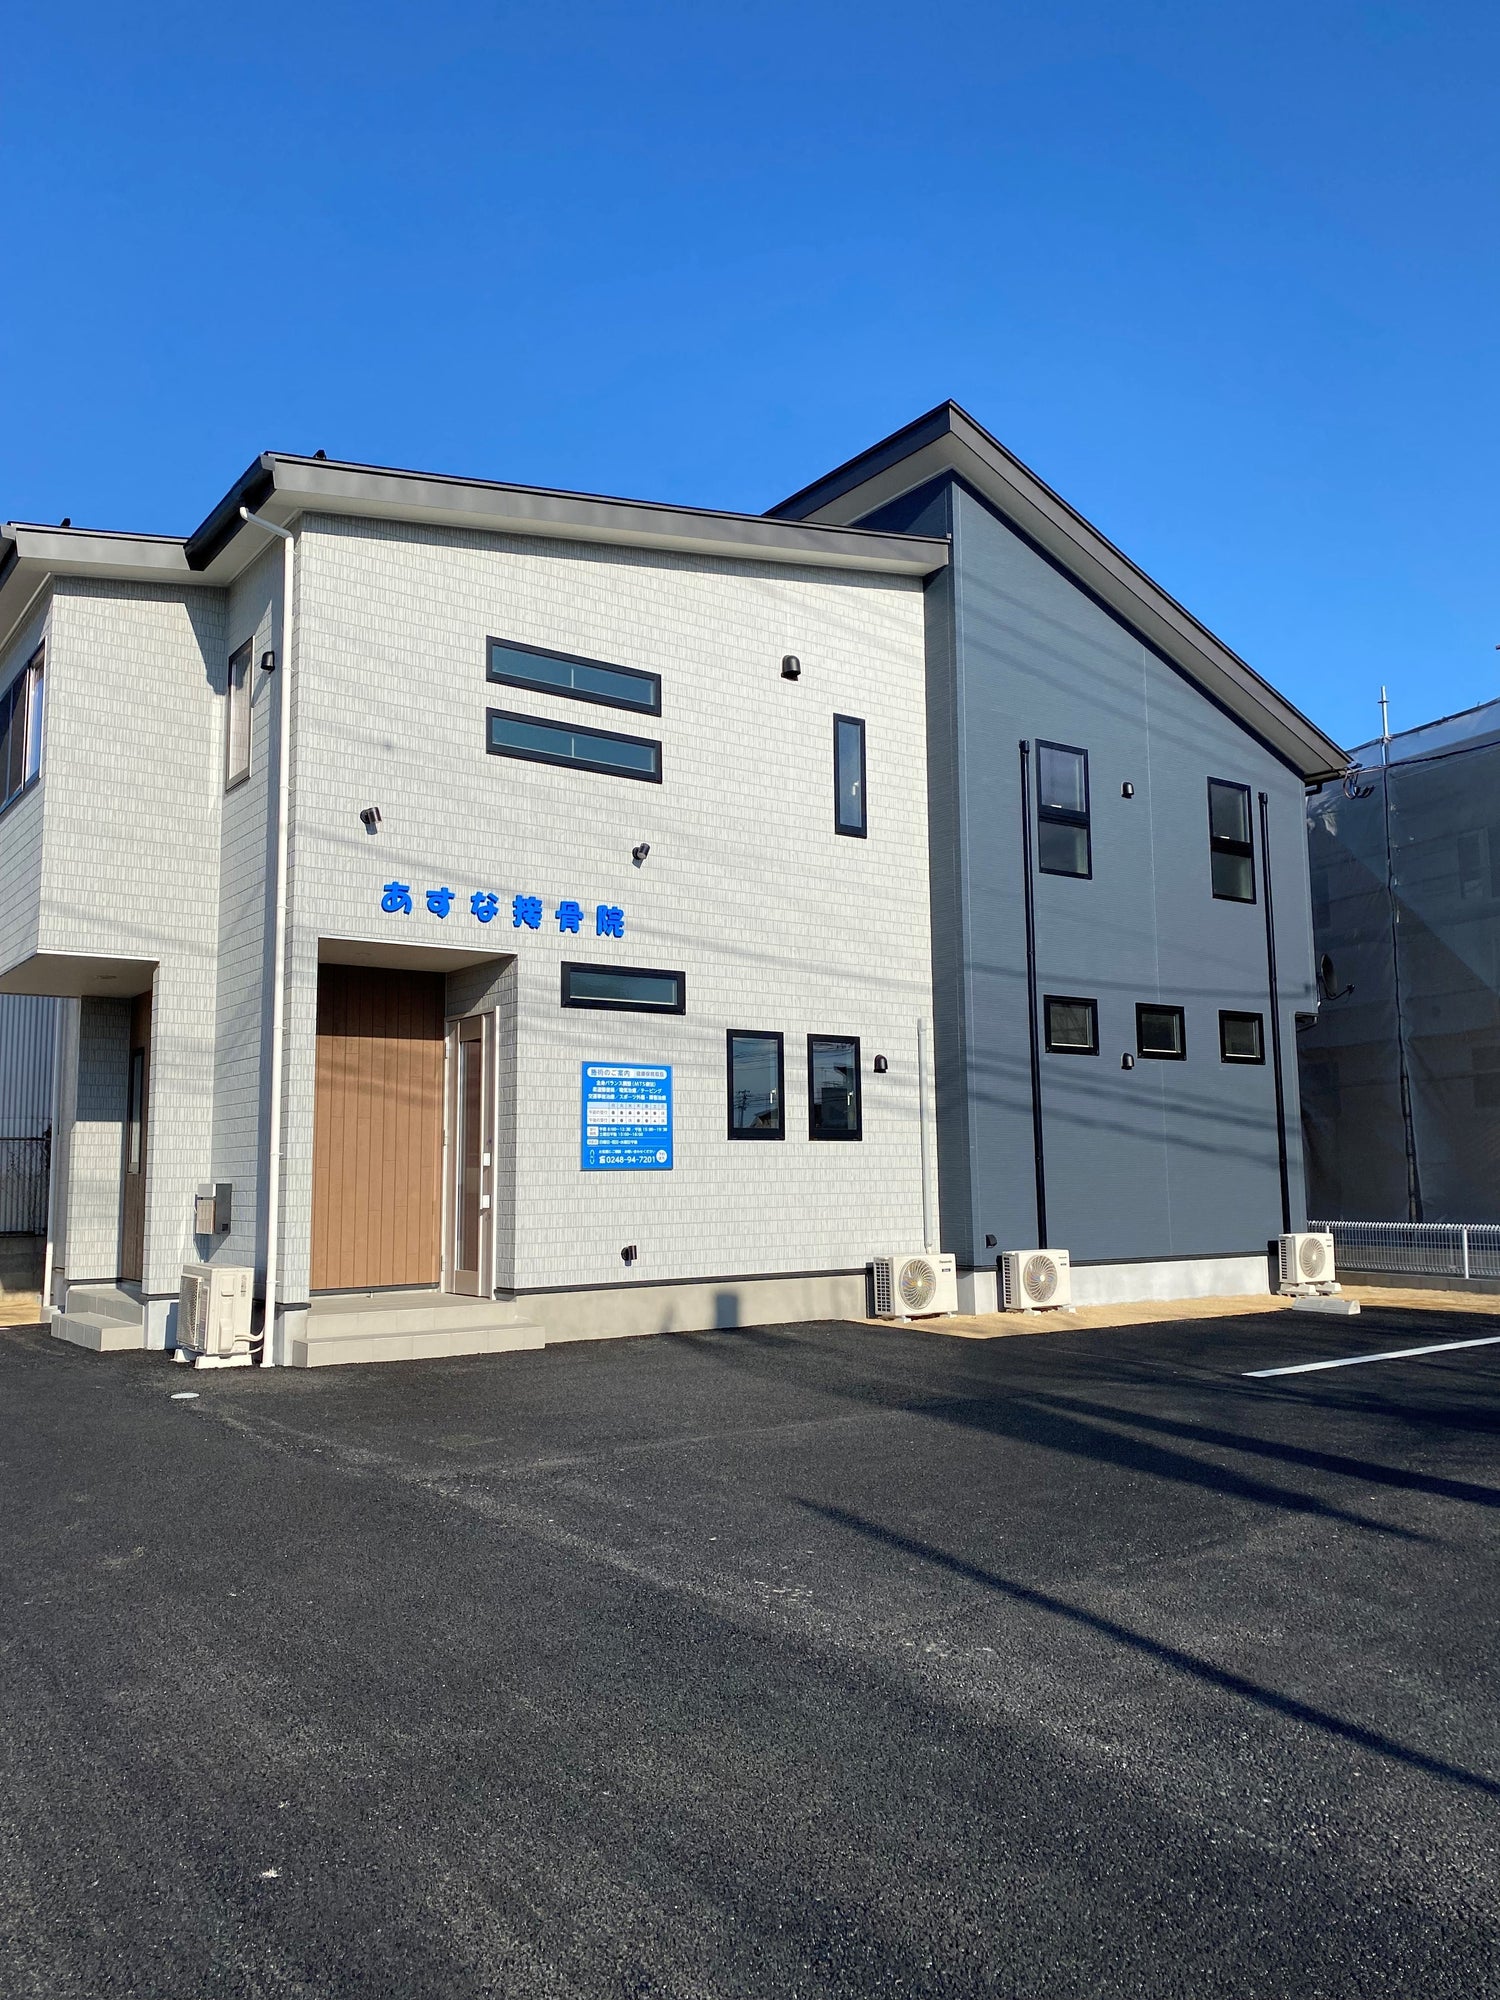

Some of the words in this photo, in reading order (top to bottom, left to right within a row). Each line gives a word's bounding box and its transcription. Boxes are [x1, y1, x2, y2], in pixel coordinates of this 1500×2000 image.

[381, 881, 625, 937] あすな接骨院
[606, 1155, 656, 1164] 0248-94-7201
